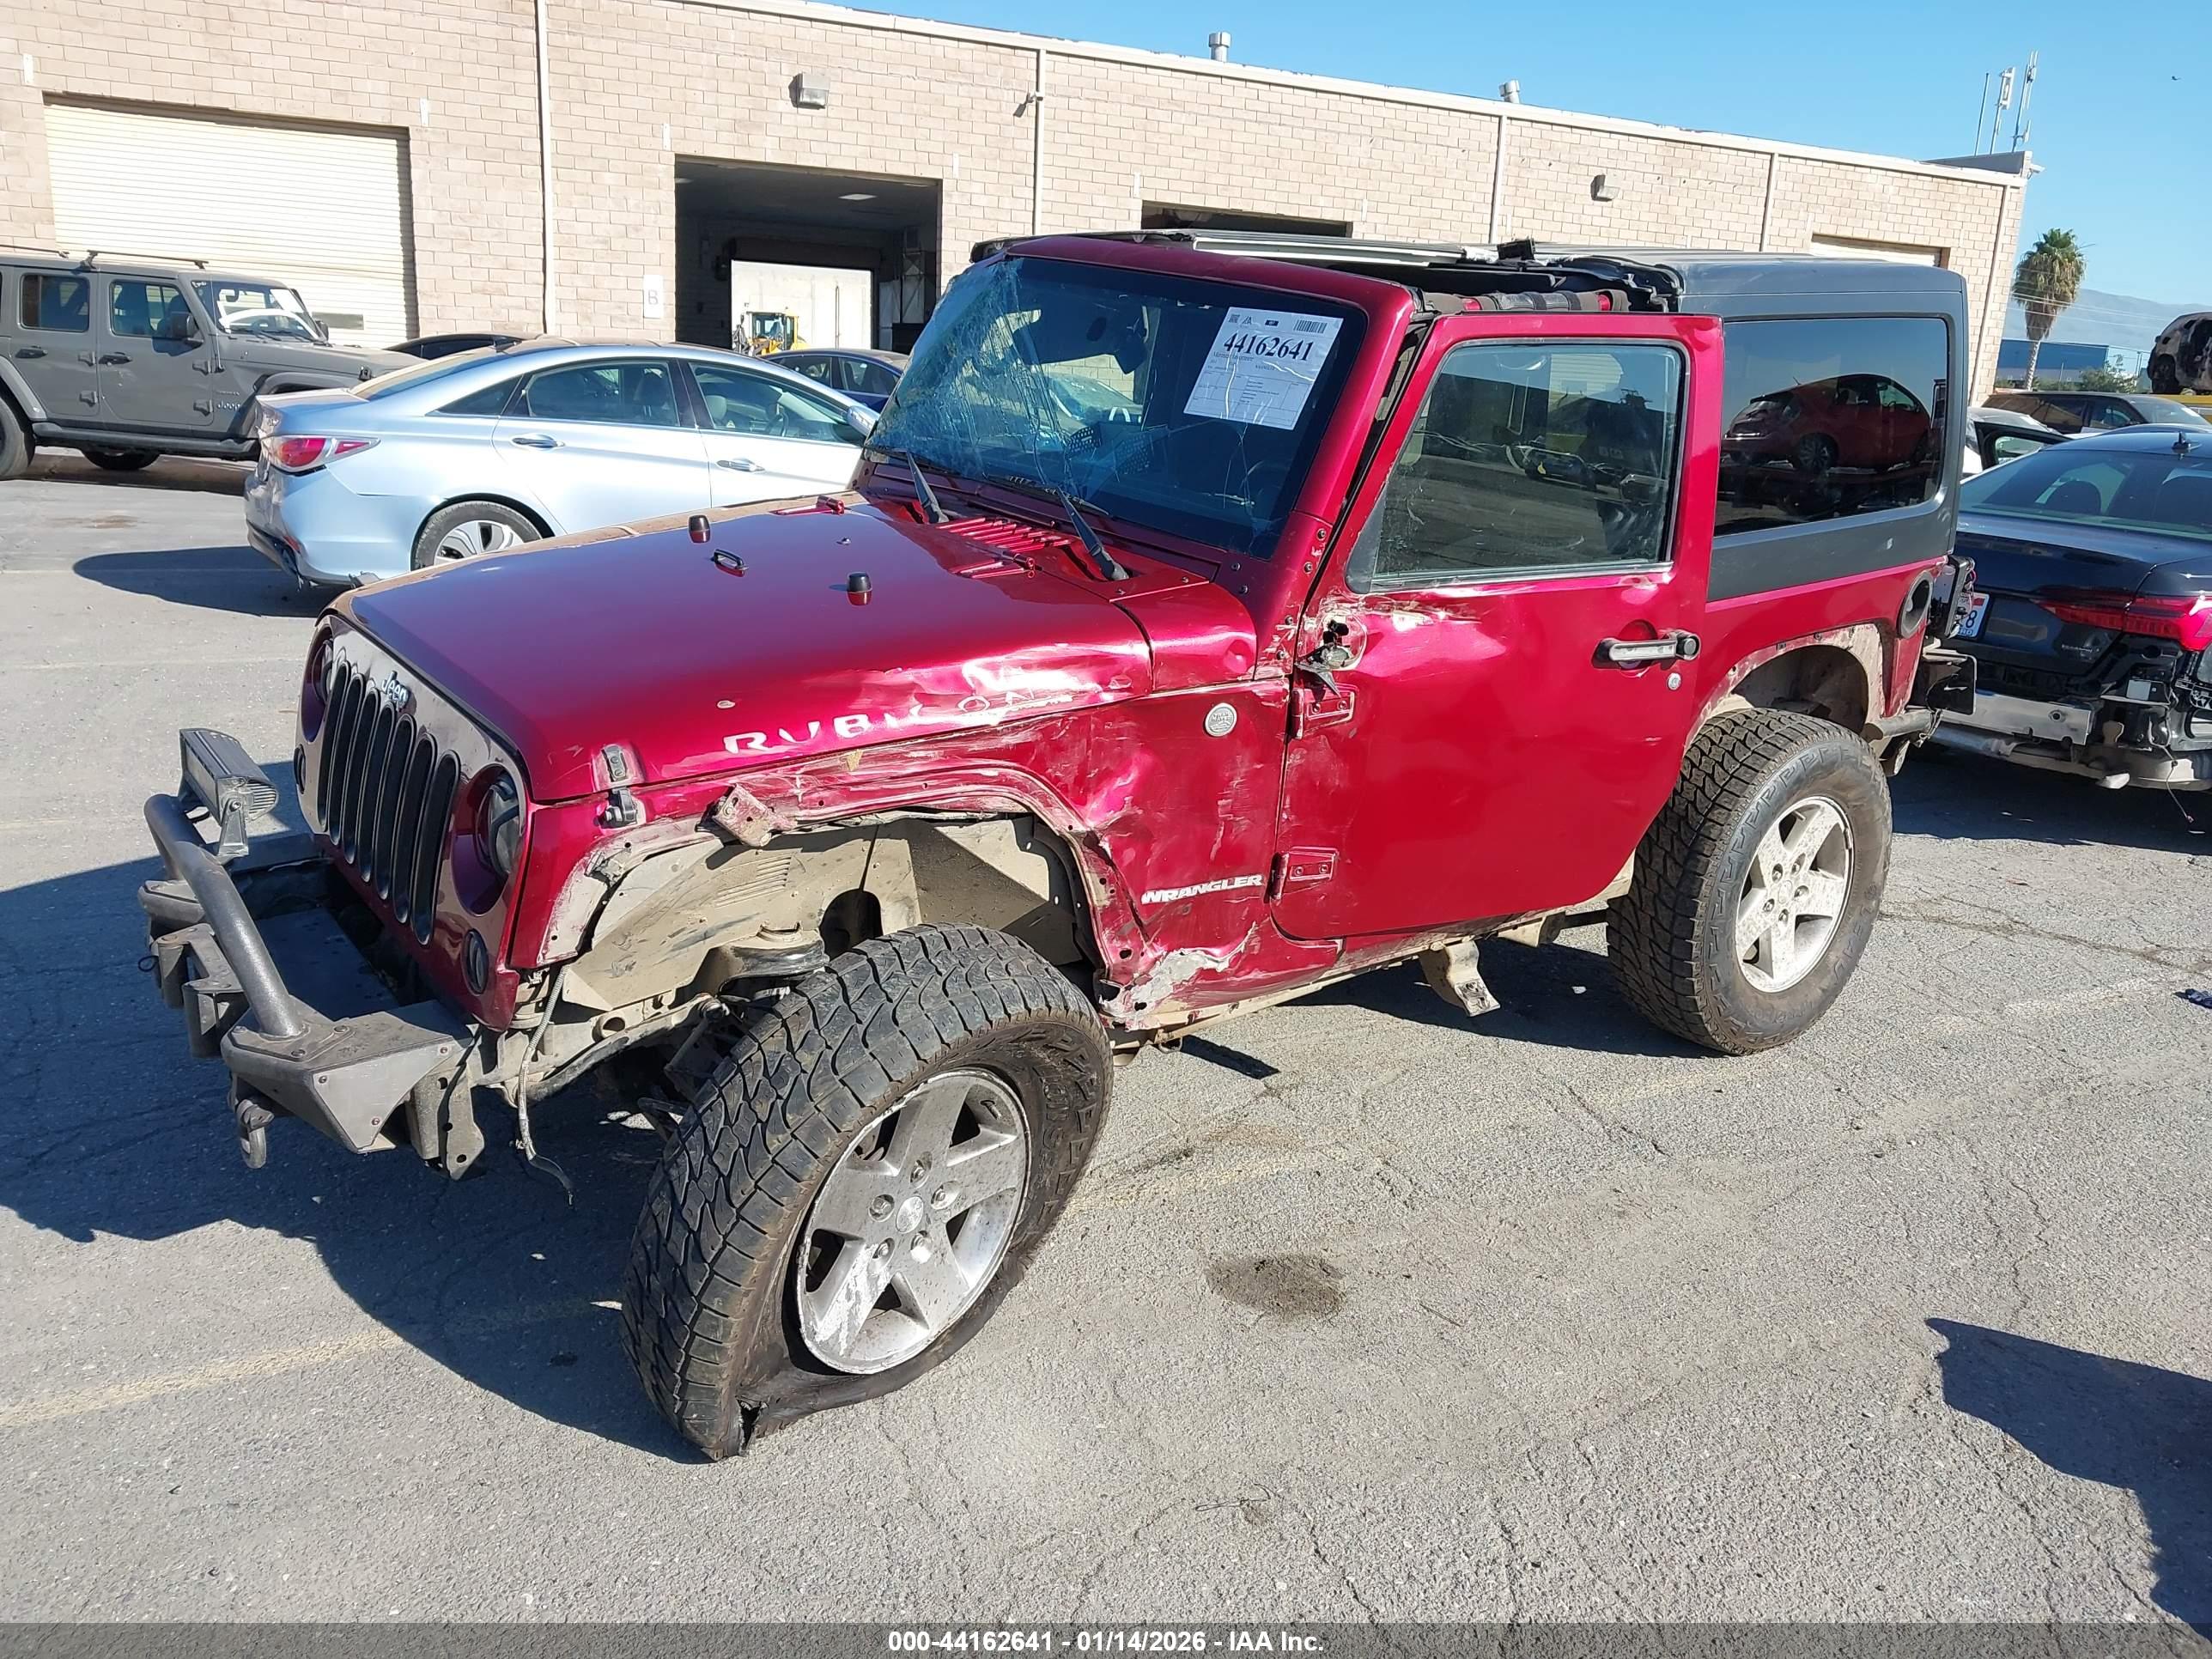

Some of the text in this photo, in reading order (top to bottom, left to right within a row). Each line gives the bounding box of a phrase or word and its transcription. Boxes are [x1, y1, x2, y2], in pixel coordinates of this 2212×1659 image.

[647, 289, 659, 306] B
[1224, 332, 1314, 361] 44162641
[381, 670, 409, 712] Jeep
[723, 689, 1036, 755] RUBICON
[1140, 874, 1265, 905] WRANGLER
